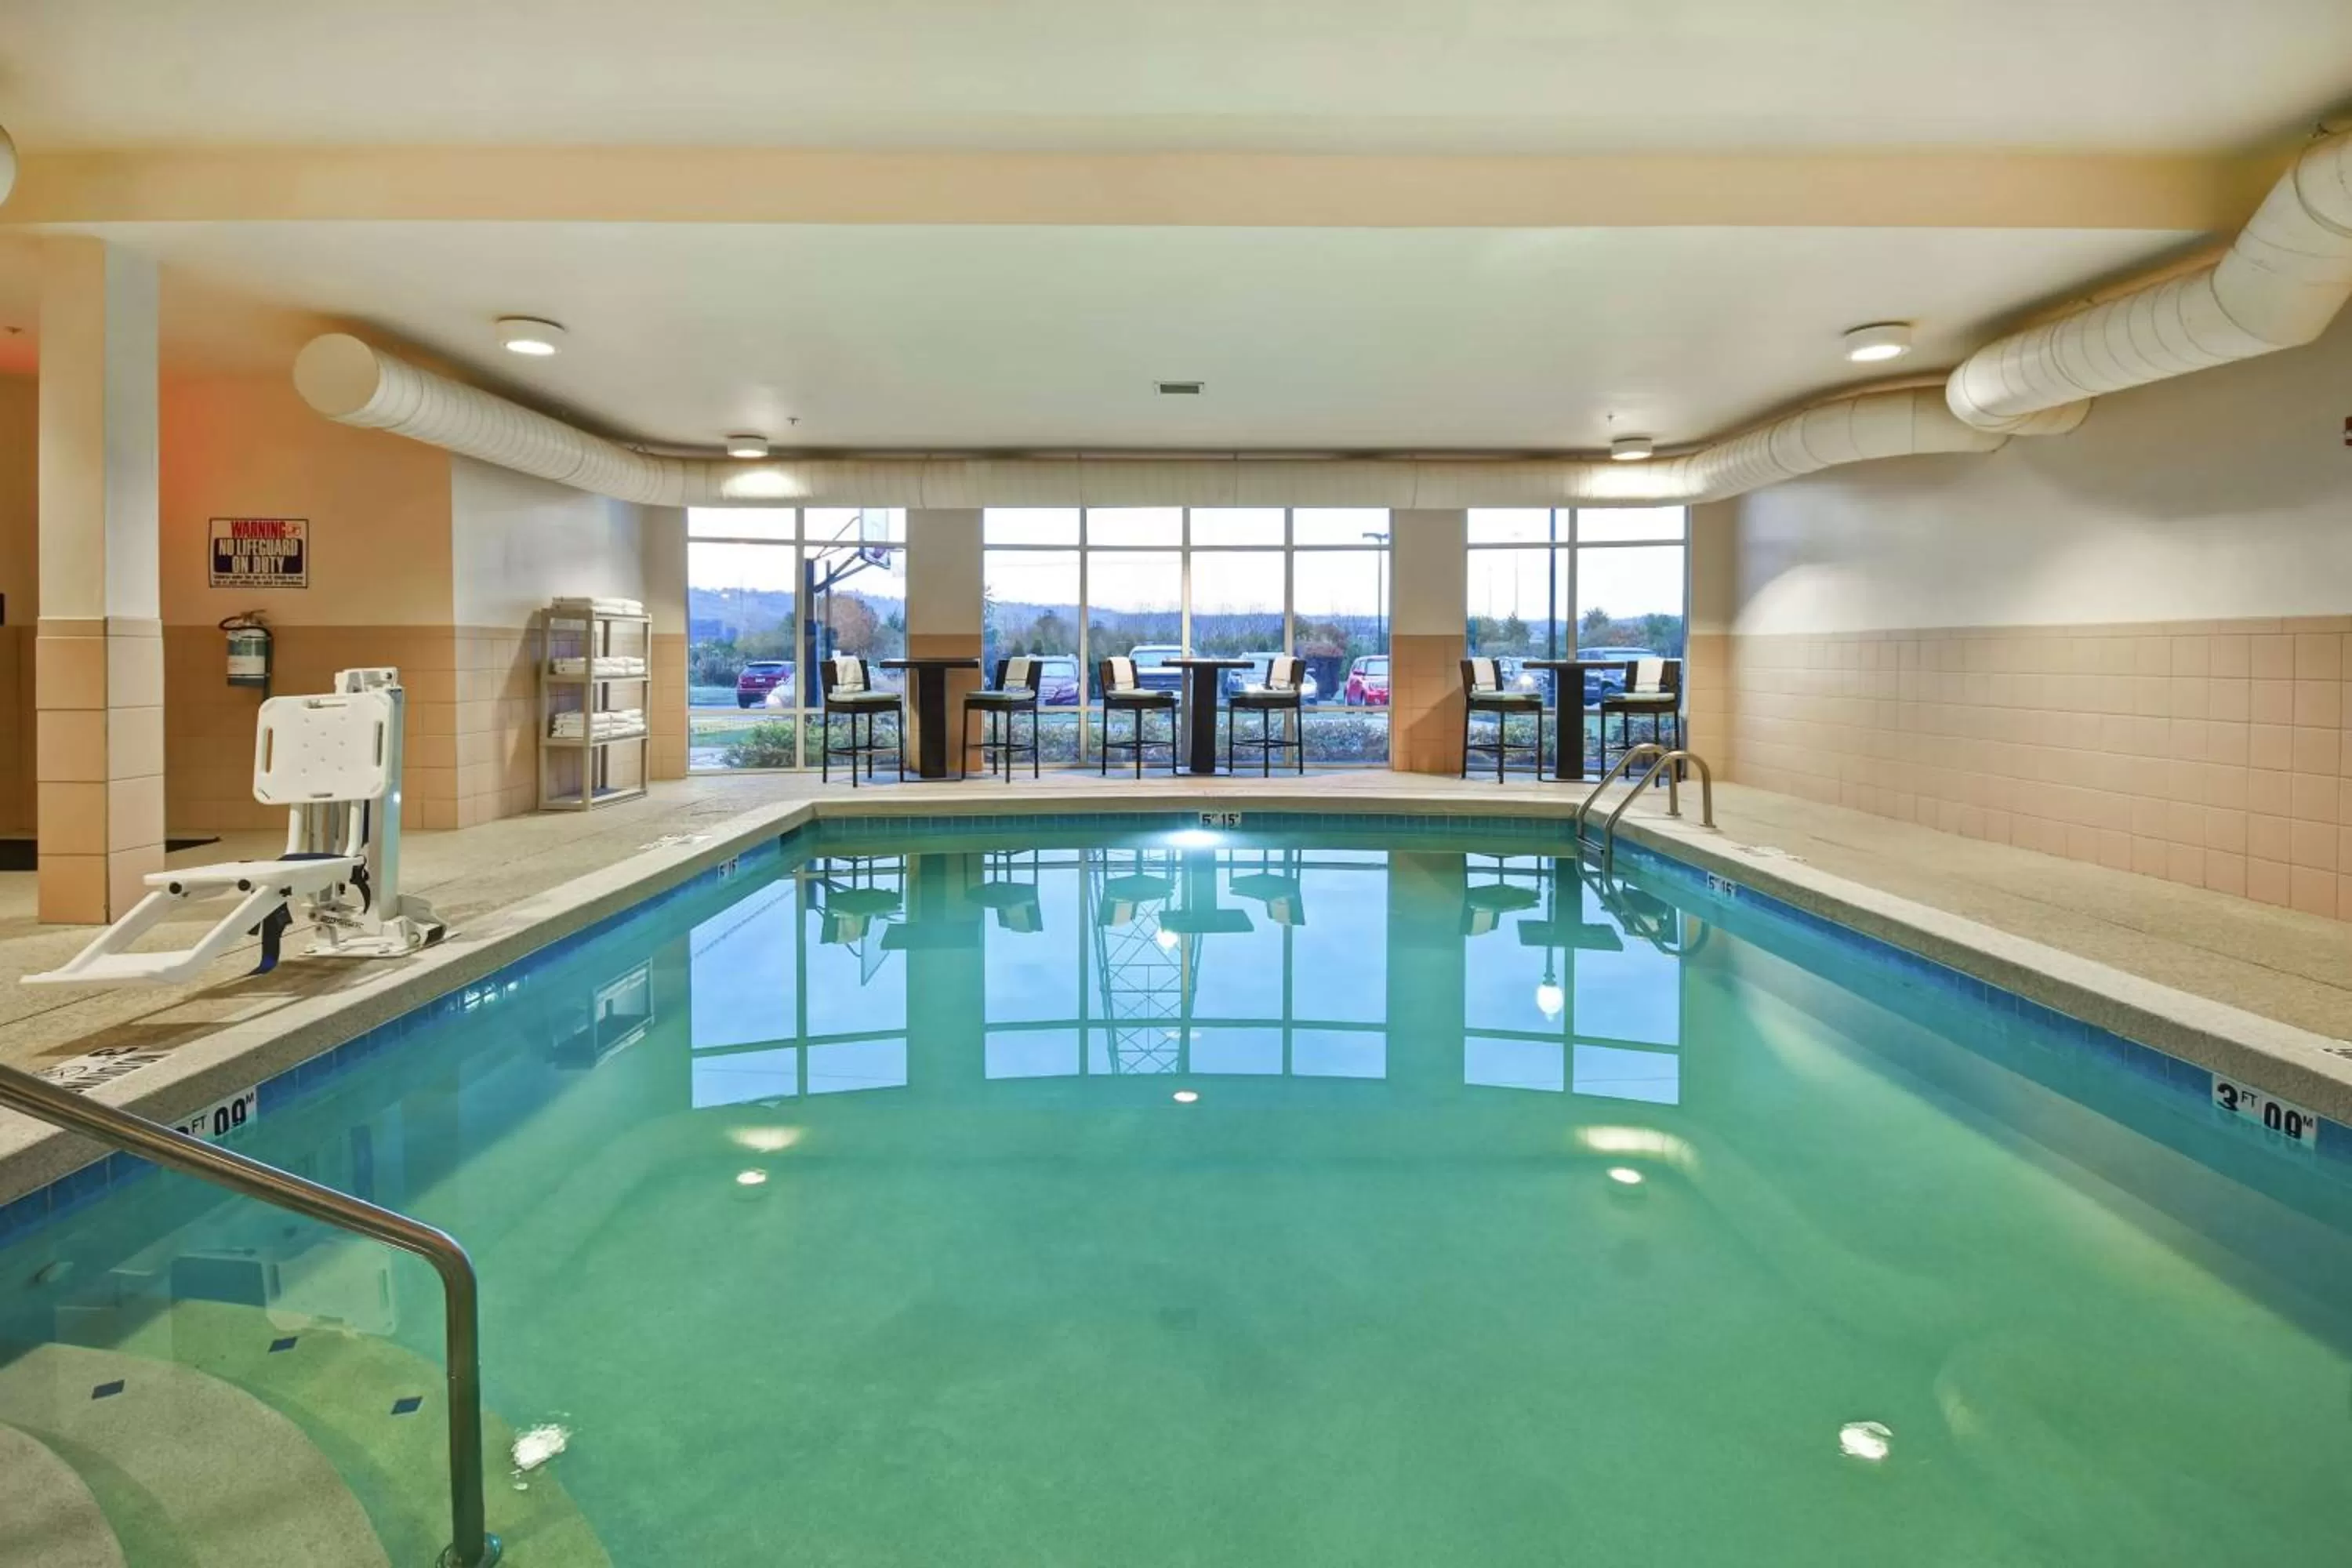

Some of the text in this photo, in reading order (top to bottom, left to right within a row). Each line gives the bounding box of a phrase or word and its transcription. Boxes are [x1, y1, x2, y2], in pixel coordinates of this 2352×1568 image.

[230, 521, 285, 539] WARNING
[219, 539, 299, 556] NO LIFEGUARD
[231, 556, 285, 574] ON DUTY
